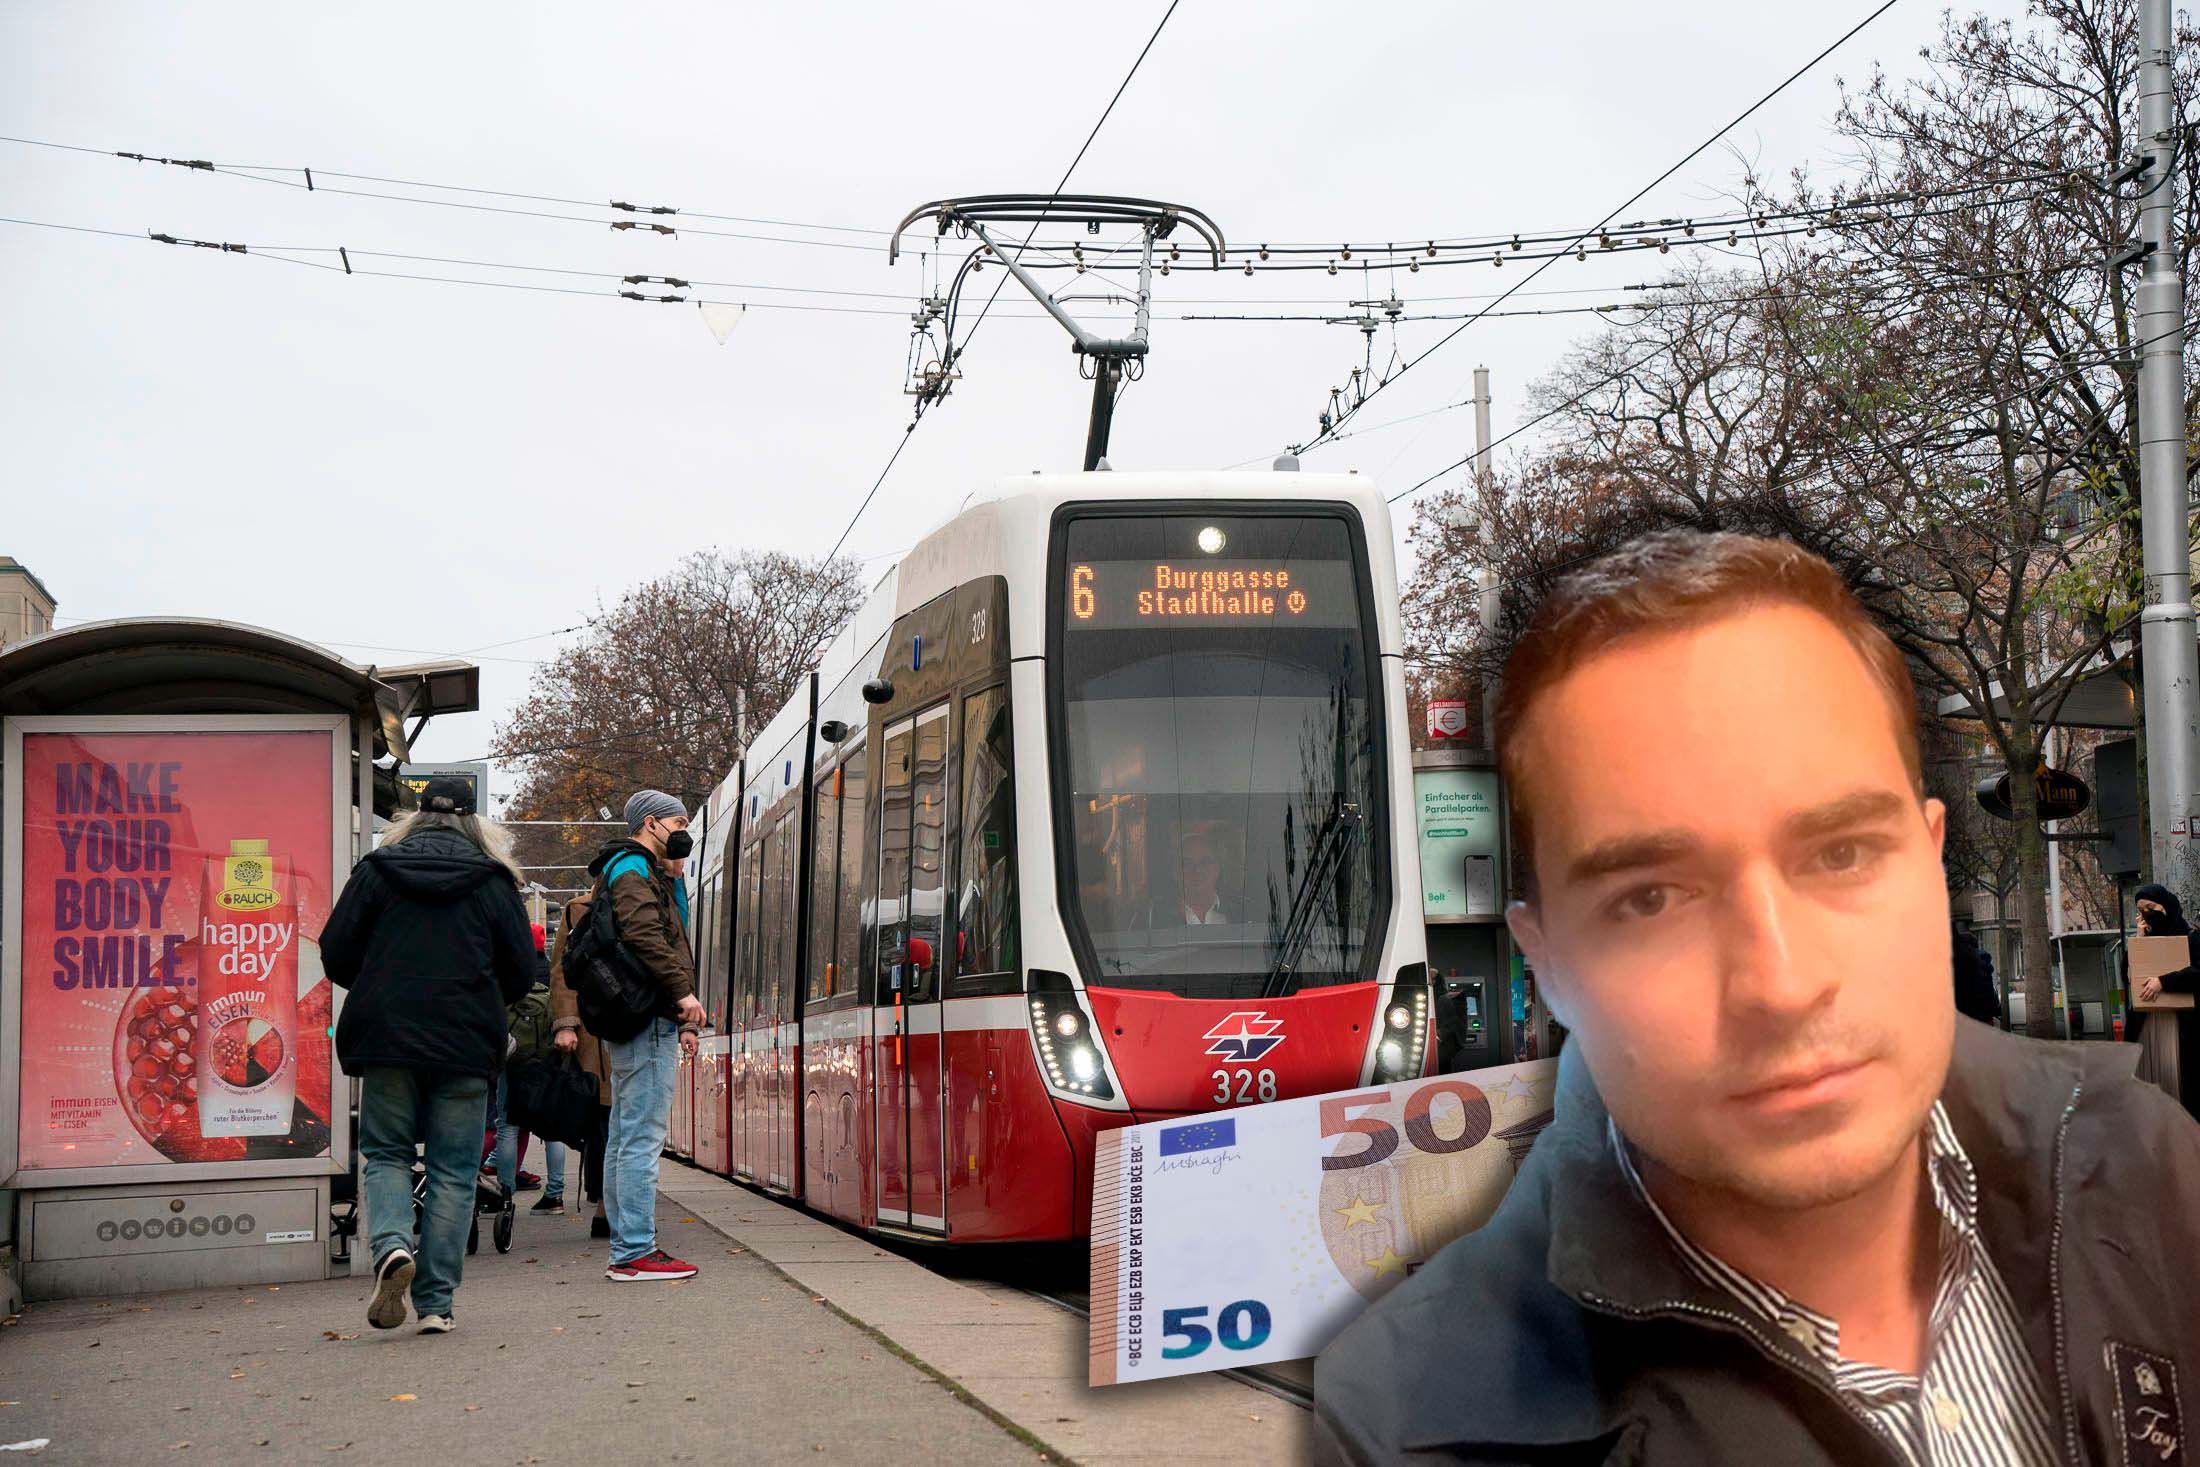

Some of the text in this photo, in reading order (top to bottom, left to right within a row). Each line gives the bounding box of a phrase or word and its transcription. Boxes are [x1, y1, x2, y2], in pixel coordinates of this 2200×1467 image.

[1156, 566, 1289, 592] Burggasse
[1072, 566, 1094, 618] 6
[1138, 591, 1275, 614] Stadthalle
[972, 608, 986, 645] 328
[55, 762, 182, 814] MAKE
[1425, 791, 1483, 802] Einfacher als
[55, 819, 171, 873] YOUR
[55, 877, 171, 931] BODY
[233, 893, 273, 905] RAUCH
[1428, 892, 1445, 902] Bolt
[203, 916, 293, 952] happy
[53, 934, 197, 990] SMILE.
[218, 946, 278, 982] day
[206, 990, 266, 1014] immun
[208, 1003, 249, 1029] EISEN
[1212, 1068, 1277, 1104] 328
[51, 1096, 117, 1108] immun EISEN
[66, 1109, 102, 1119] VITAMIN
[1320, 1080, 1491, 1171] 50
[1131, 1145, 1143, 1163] EBC
[1130, 1185, 1142, 1204] EKB
[97, 1214, 255, 1241] gewista
[1130, 1207, 1142, 1225] ESB
[1130, 1228, 1142, 1246] EKT
[1130, 1248, 1142, 1268] EKP
[1130, 1270, 1142, 1288] EZB
[1129, 1314, 1142, 1335] ECB
[1161, 1299, 1272, 1359] 50
